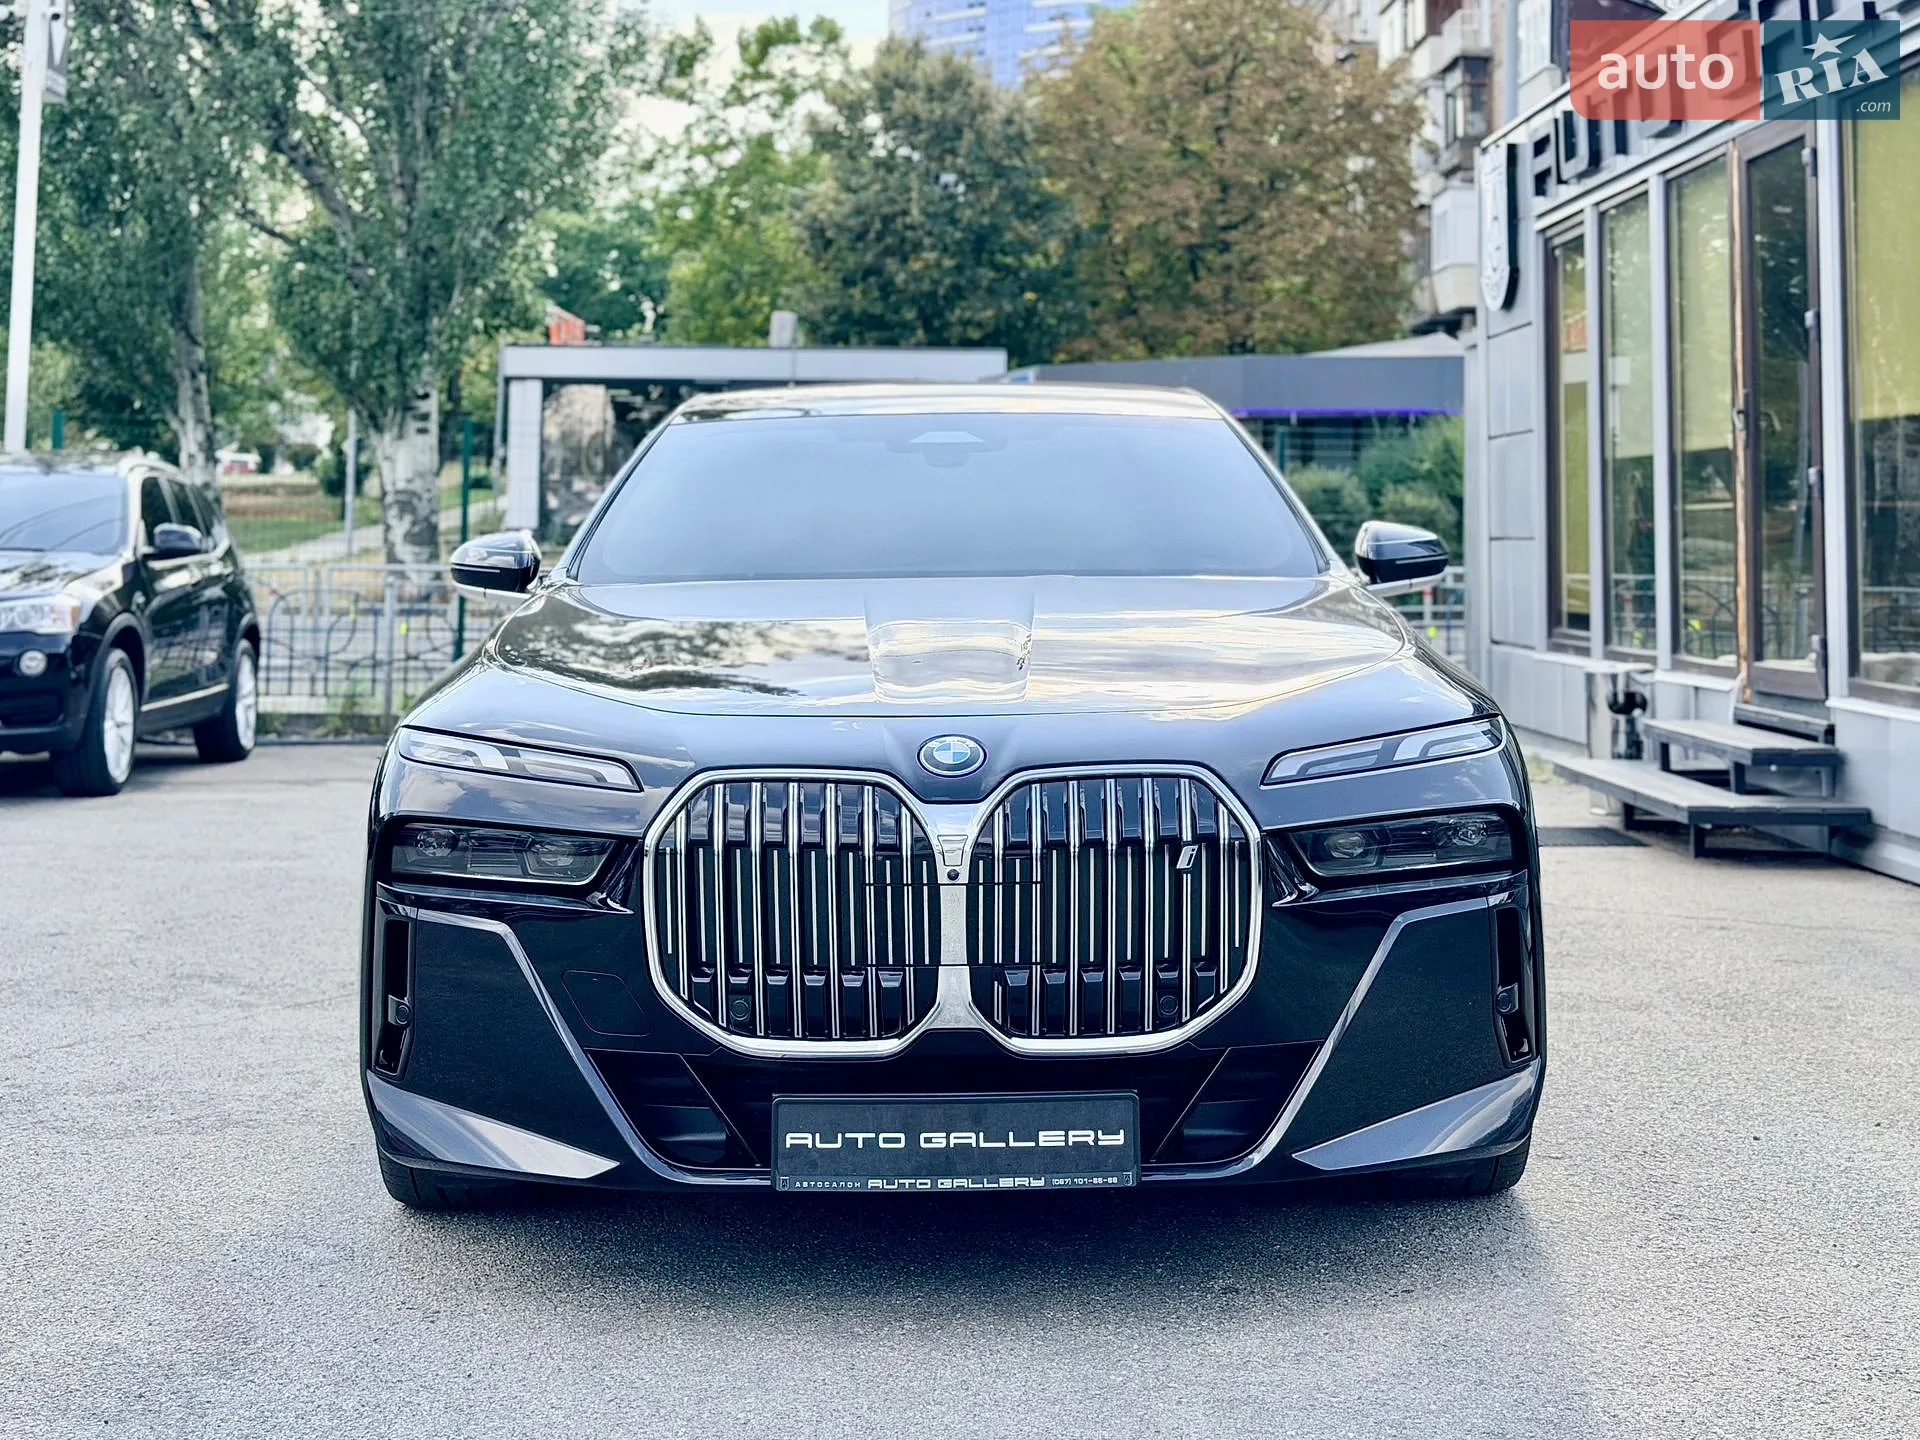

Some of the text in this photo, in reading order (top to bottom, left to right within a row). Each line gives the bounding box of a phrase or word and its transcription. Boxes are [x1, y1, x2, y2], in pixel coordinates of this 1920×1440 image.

[785, 1129, 1125, 1149] AUTO GALLERY
[867, 1178, 932, 1189] AUTO
[937, 1176, 1045, 1189] GALLERY
